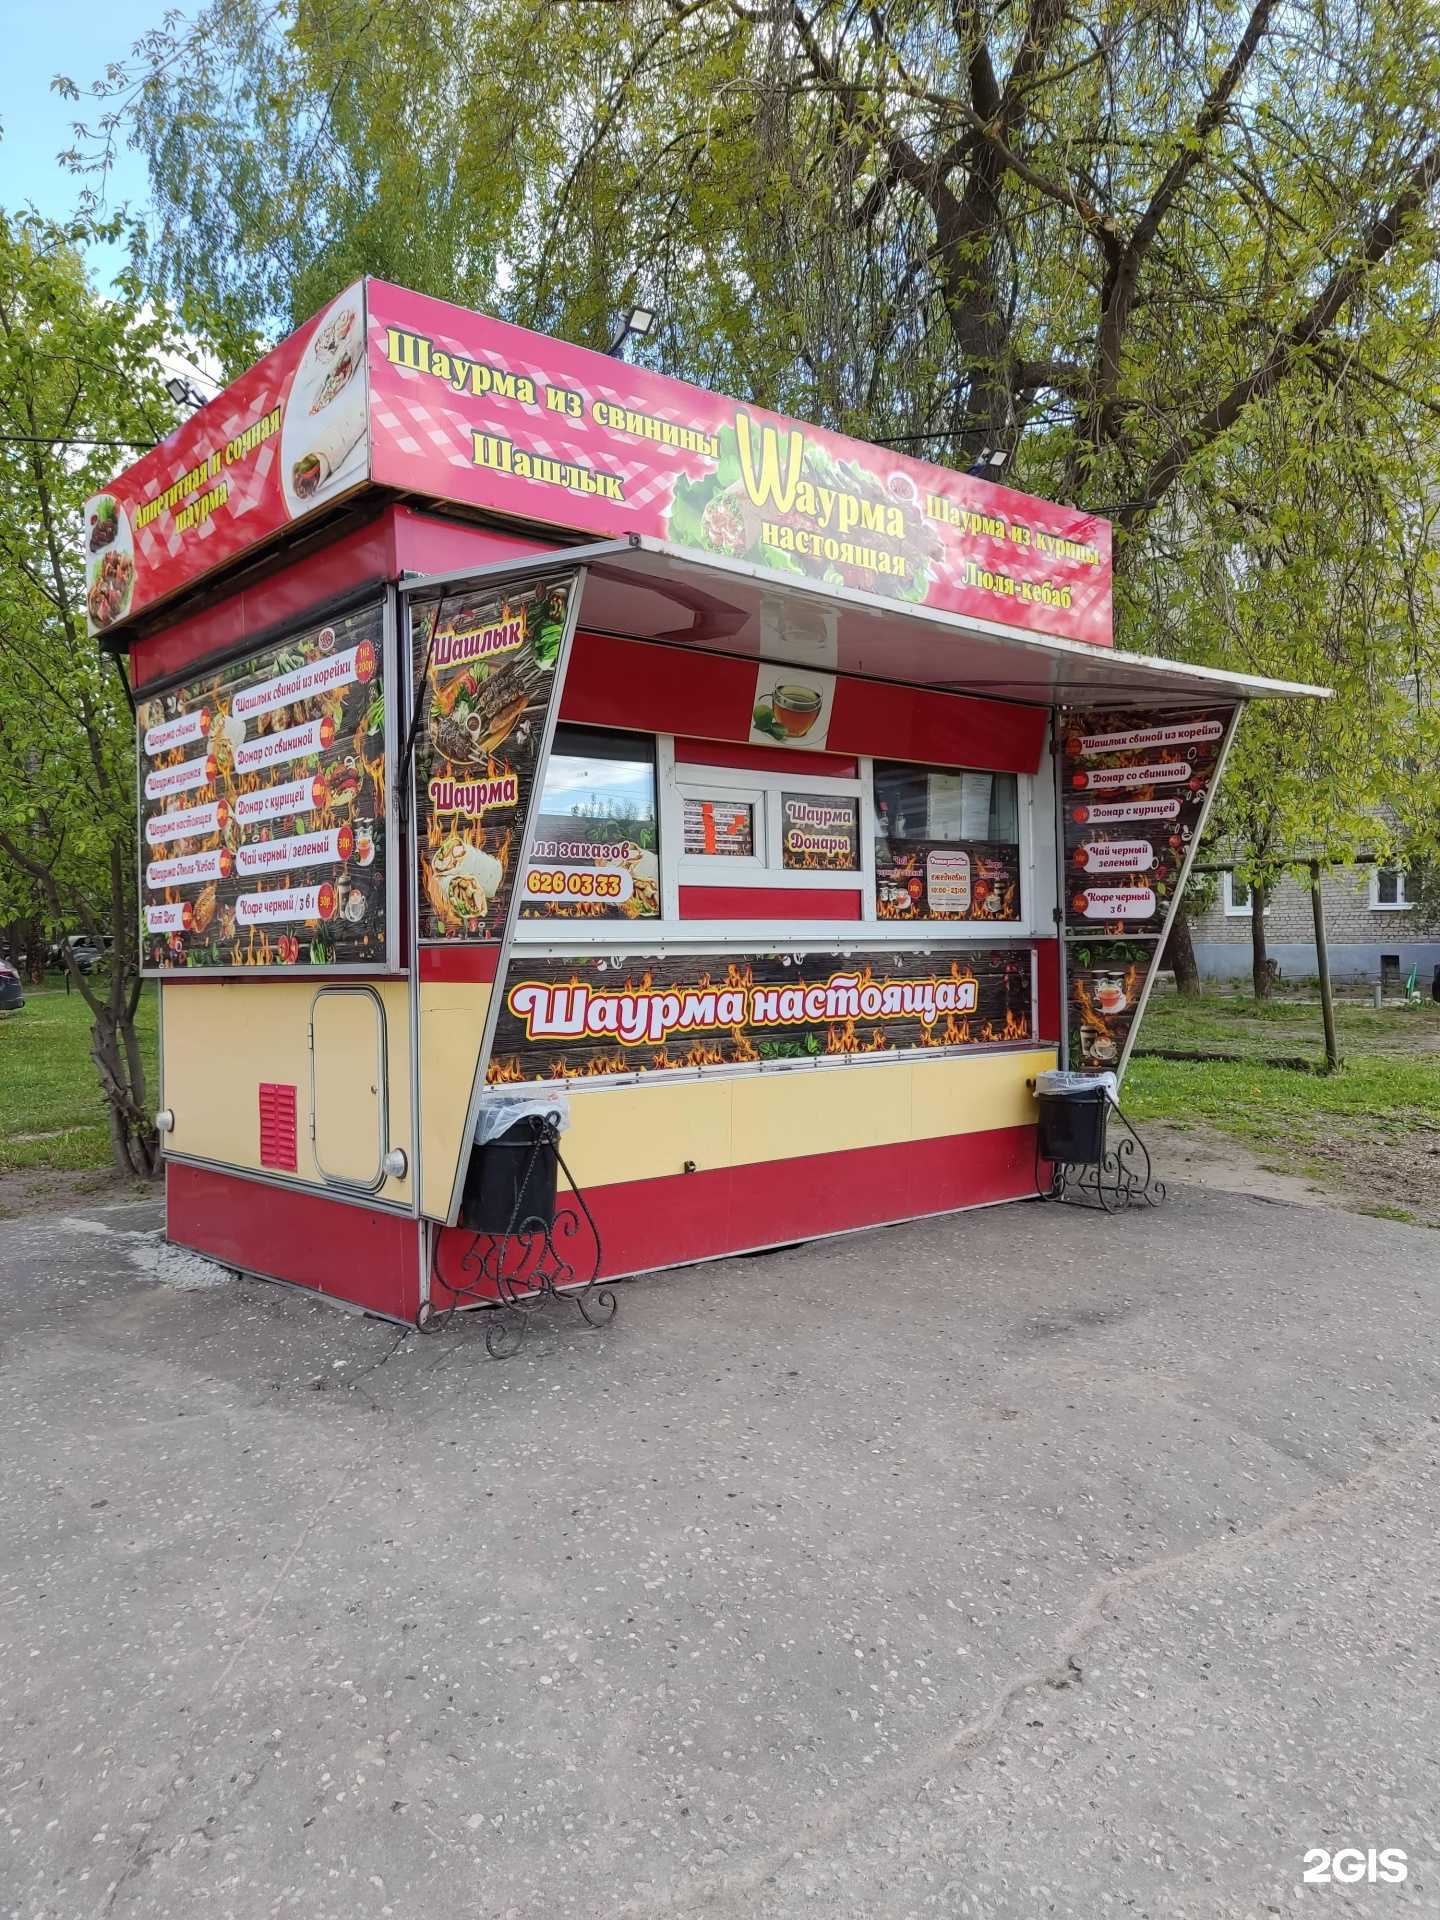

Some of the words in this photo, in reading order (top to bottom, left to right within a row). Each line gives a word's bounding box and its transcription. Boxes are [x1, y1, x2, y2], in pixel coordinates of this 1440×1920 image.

[386, 328, 536, 406] Шаурма
[546, 384, 584, 418] из
[591, 400, 721, 459] свинины
[136, 458, 208, 529] Аппетитная
[211, 448, 222, 477] и
[225, 405, 281, 465] сочная
[472, 429, 625, 502] Шашлык
[175, 480, 229, 534] шаурма
[927, 494, 1006, 539] Шаурма
[1010, 524, 1032, 546] из
[1036, 531, 1101, 566] курицы
[761, 521, 906, 578] настоящая
[961, 561, 1072, 609] Люля-кебаб
[432, 621, 521, 665] Шашлык
[235, 690, 272, 713] Шашлык
[273, 675, 301, 700] свиной
[302, 674, 312, 688] из
[313, 660, 351, 686] корейки
[237, 747, 263, 765] Донар
[264, 746, 273, 757] со
[274, 728, 313, 753] свининой
[1083, 738, 1127, 749] Шашлык
[1129, 731, 1163, 744] свиной
[1165, 731, 1176, 740] из
[1178, 724, 1220, 740] корейки
[1093, 773, 1124, 784] Донар
[1138, 766, 1186, 779] свининой
[238, 799, 264, 816] Донар
[265, 799, 270, 809] с
[270, 785, 305, 811] курицей
[431, 778, 515, 814] Шаурма
[1093, 807, 1124, 817] Донар
[1133, 804, 1175, 817] курицей
[787, 803, 851, 825] Шаурма
[240, 848, 257, 866] Чай
[258, 844, 287, 867] черный
[292, 836, 329, 858] зеленый
[560, 841, 629, 859] заказов
[790, 831, 848, 855] Донары
[1089, 846, 1110, 856] Чай
[1112, 844, 1148, 856] черный
[1098, 857, 1139, 867] зеленый
[527, 870, 565, 894] 626
[567, 873, 594, 896] 03
[596, 874, 621, 896] 33
[1087, 892, 1114, 903] Кофе
[1115, 890, 1151, 902] черный
[240, 900, 262, 917] Кофе
[264, 895, 293, 916] черный
[512, 982, 745, 1044] Шаурма
[751, 972, 976, 1024] настоящая
